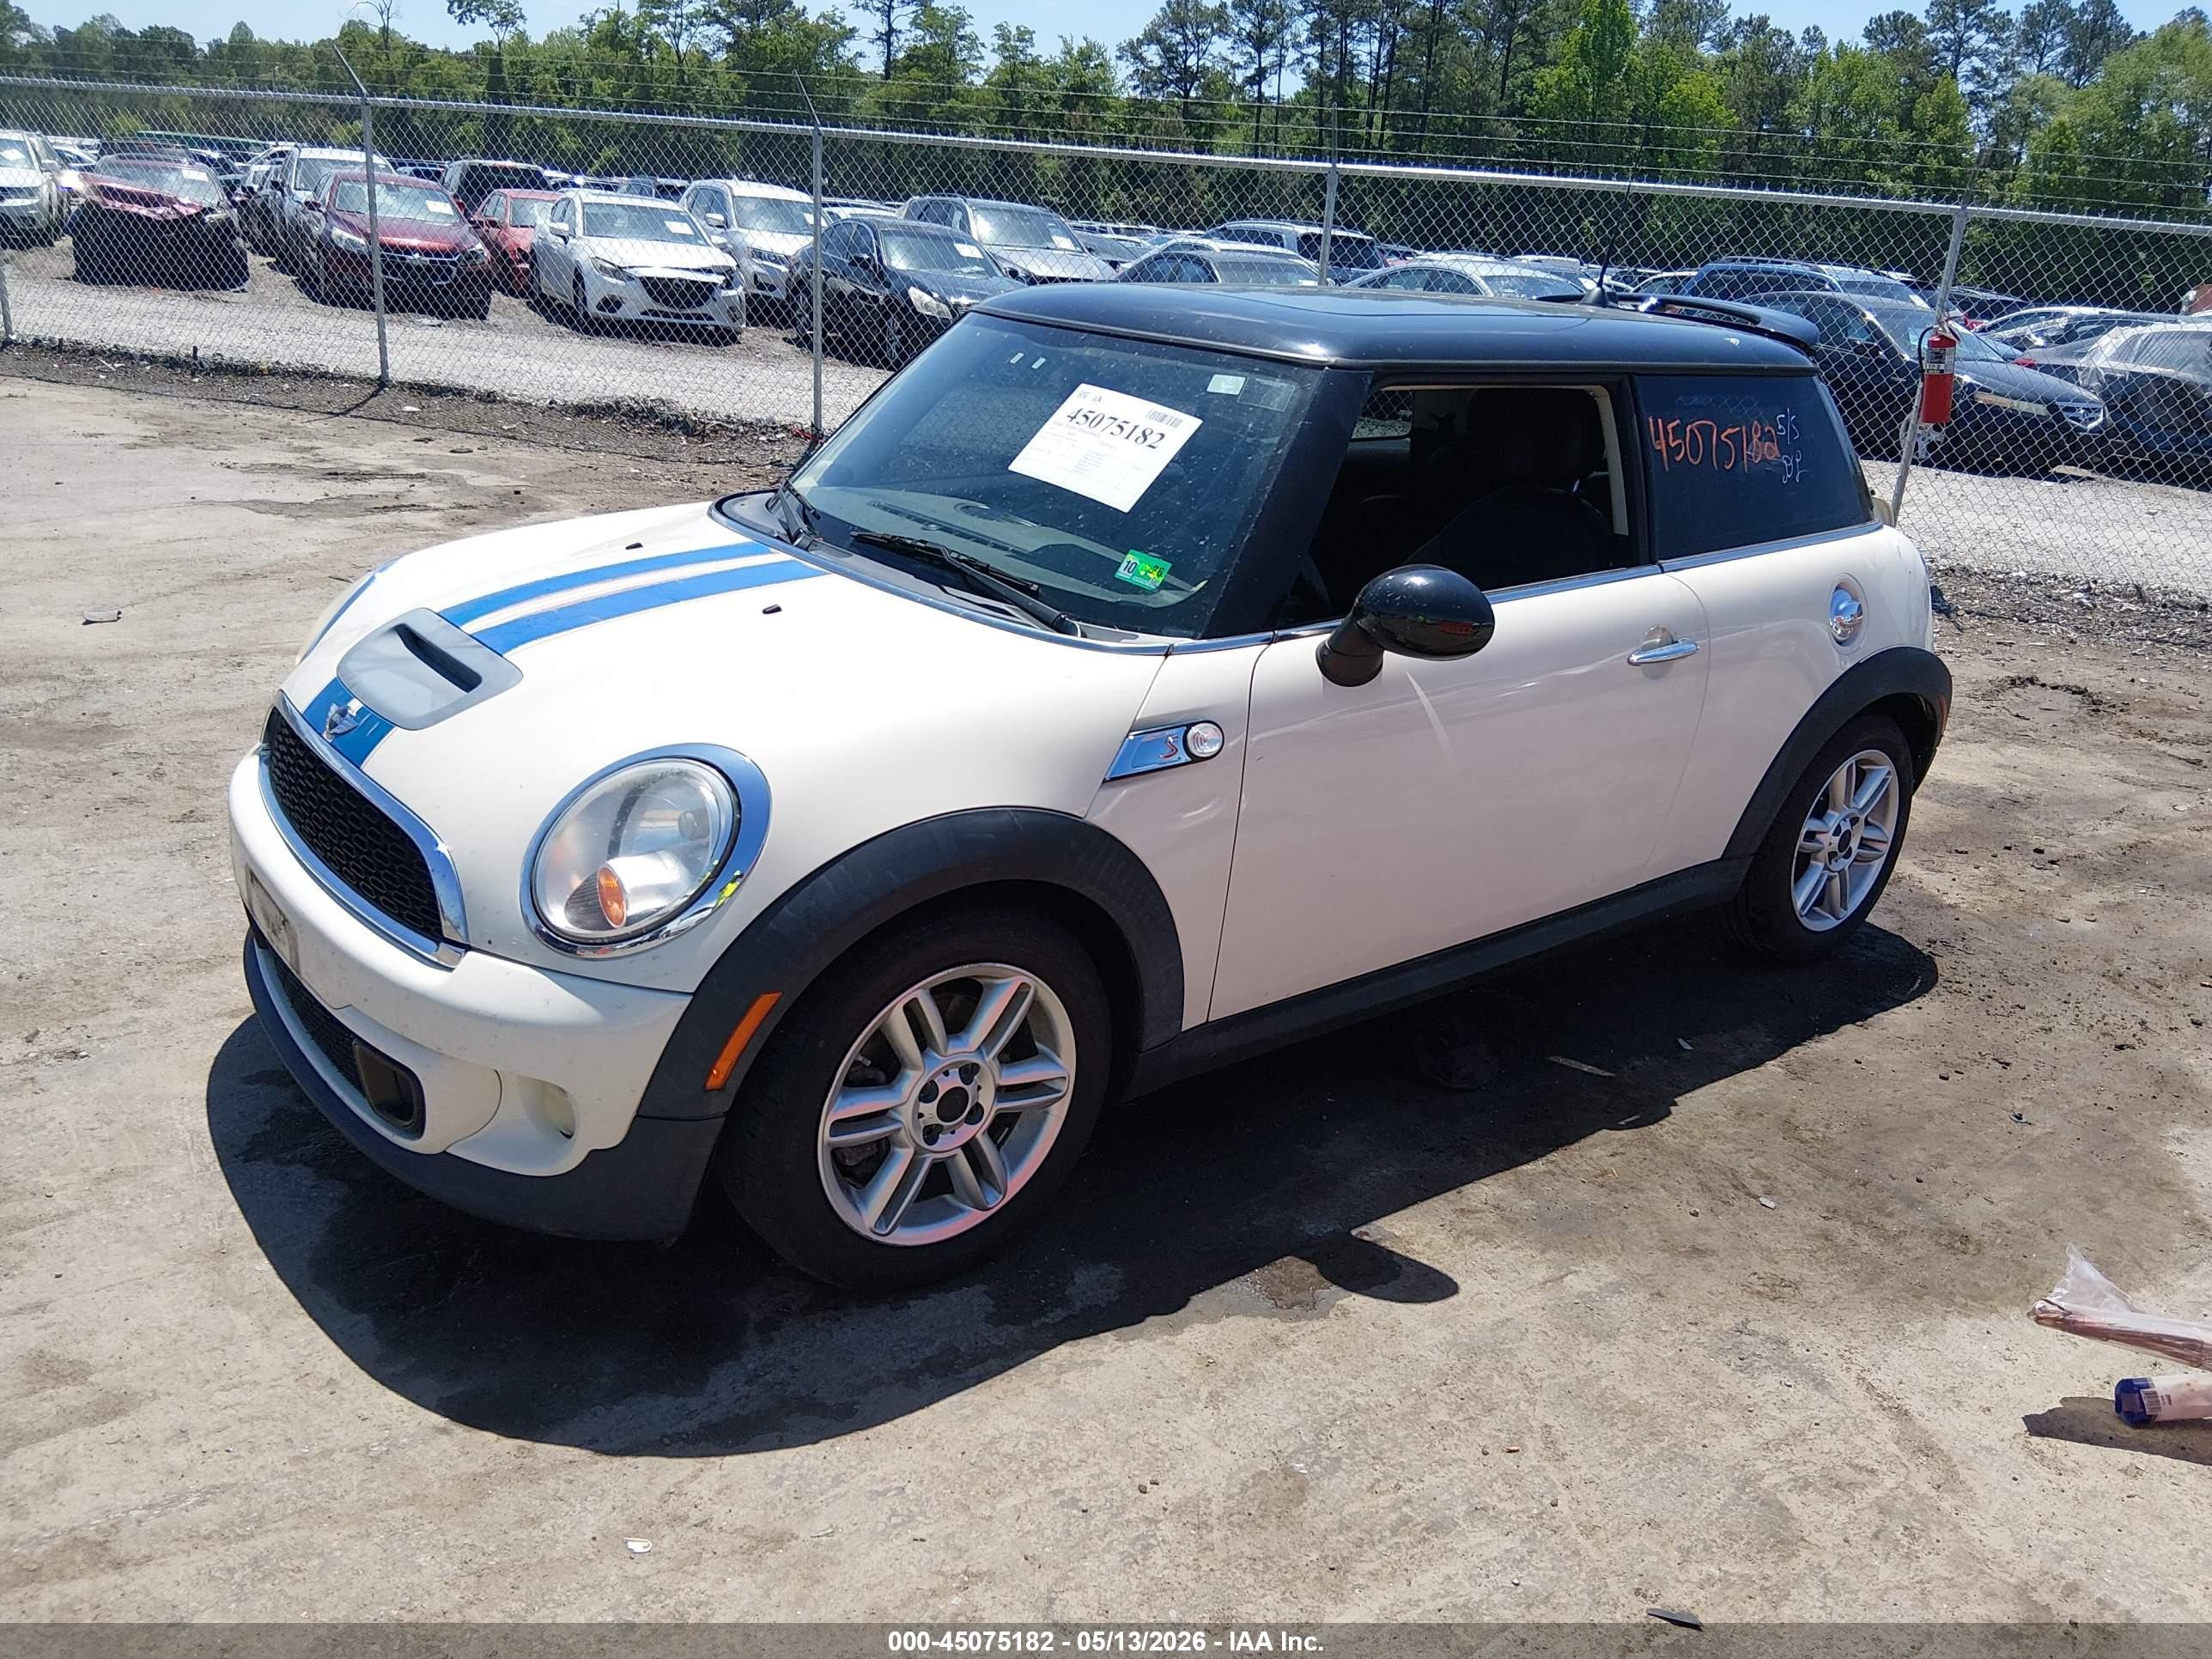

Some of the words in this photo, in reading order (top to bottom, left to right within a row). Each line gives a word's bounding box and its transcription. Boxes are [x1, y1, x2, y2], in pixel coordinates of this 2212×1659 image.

[1066, 408, 1166, 450] 45075182
[1648, 416, 1781, 473] 45075182
[1122, 560, 1139, 574] 10
